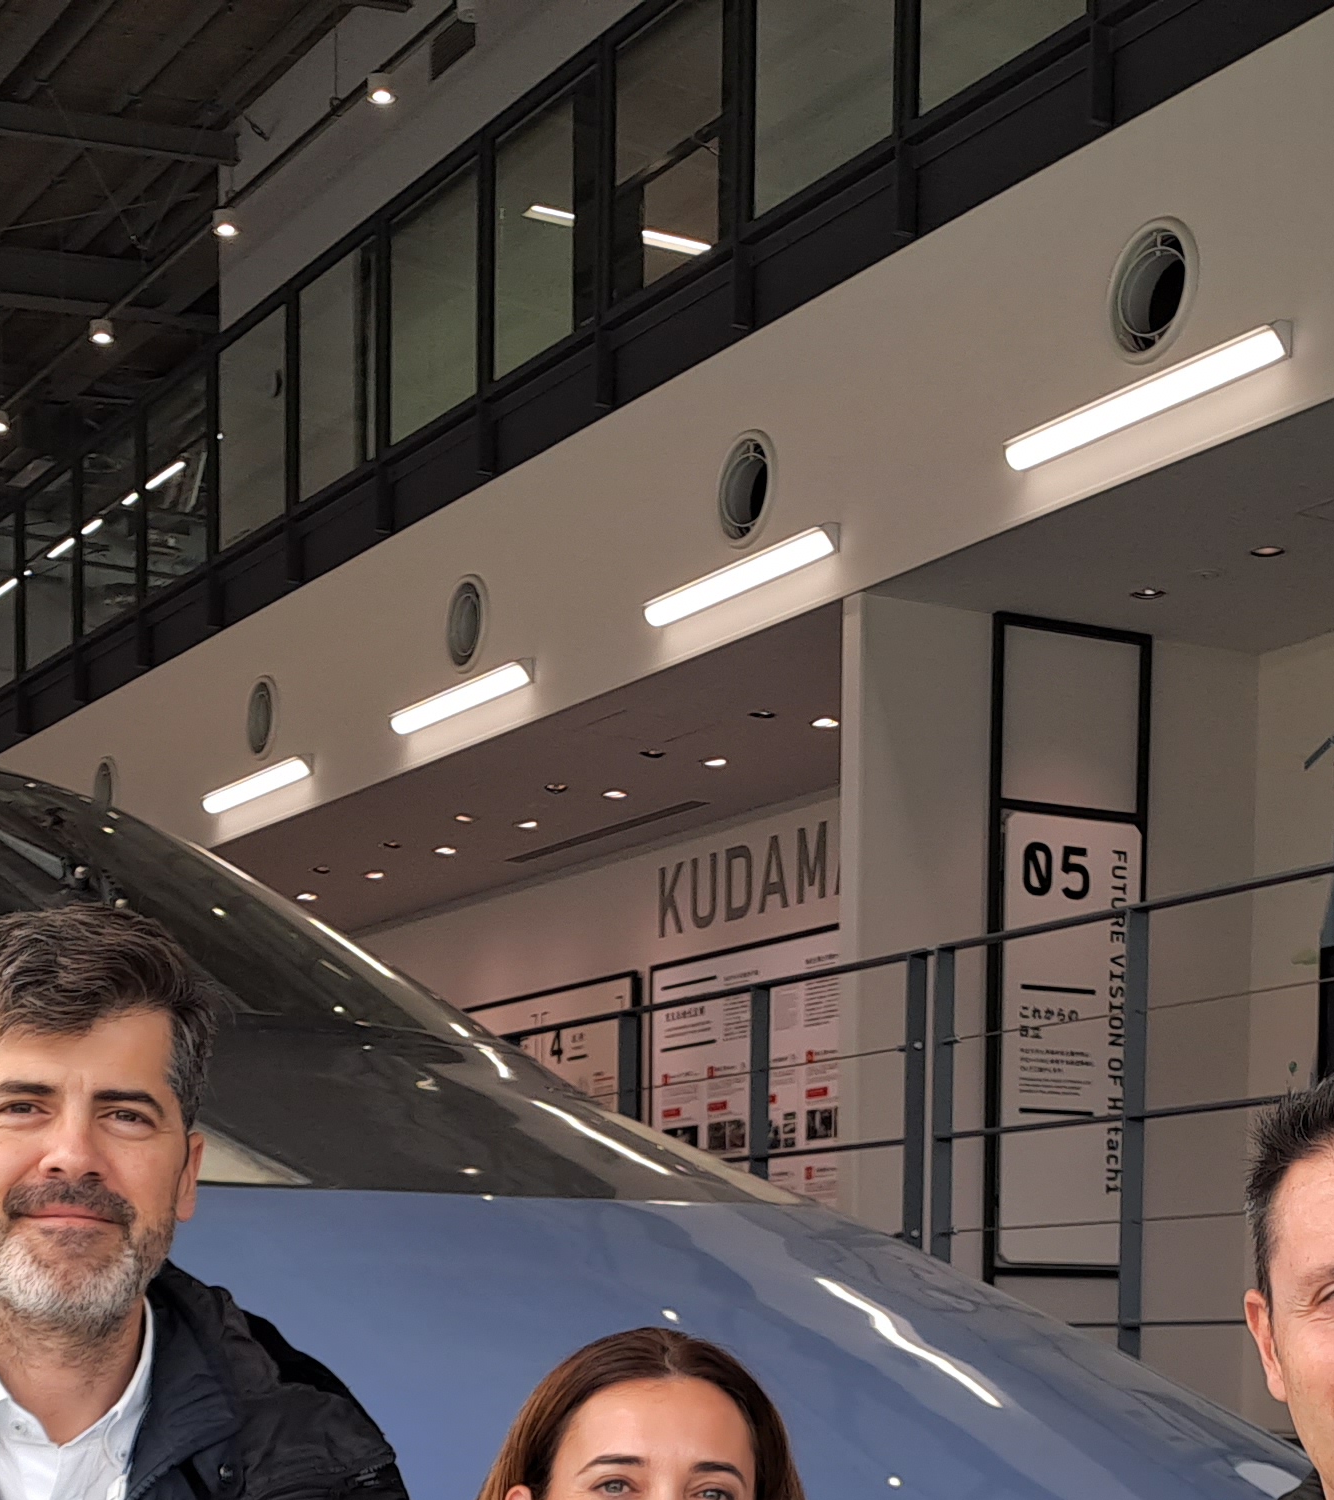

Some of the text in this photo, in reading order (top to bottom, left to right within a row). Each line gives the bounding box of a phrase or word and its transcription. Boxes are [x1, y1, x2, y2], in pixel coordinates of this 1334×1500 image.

[658, 821, 840, 938] KUDAM
[1024, 842, 1089, 900] 05
[1109, 954, 1125, 1047] VISION
[1108, 1058, 1124, 1085] OF
[1106, 1097, 1123, 1194] Htachi
